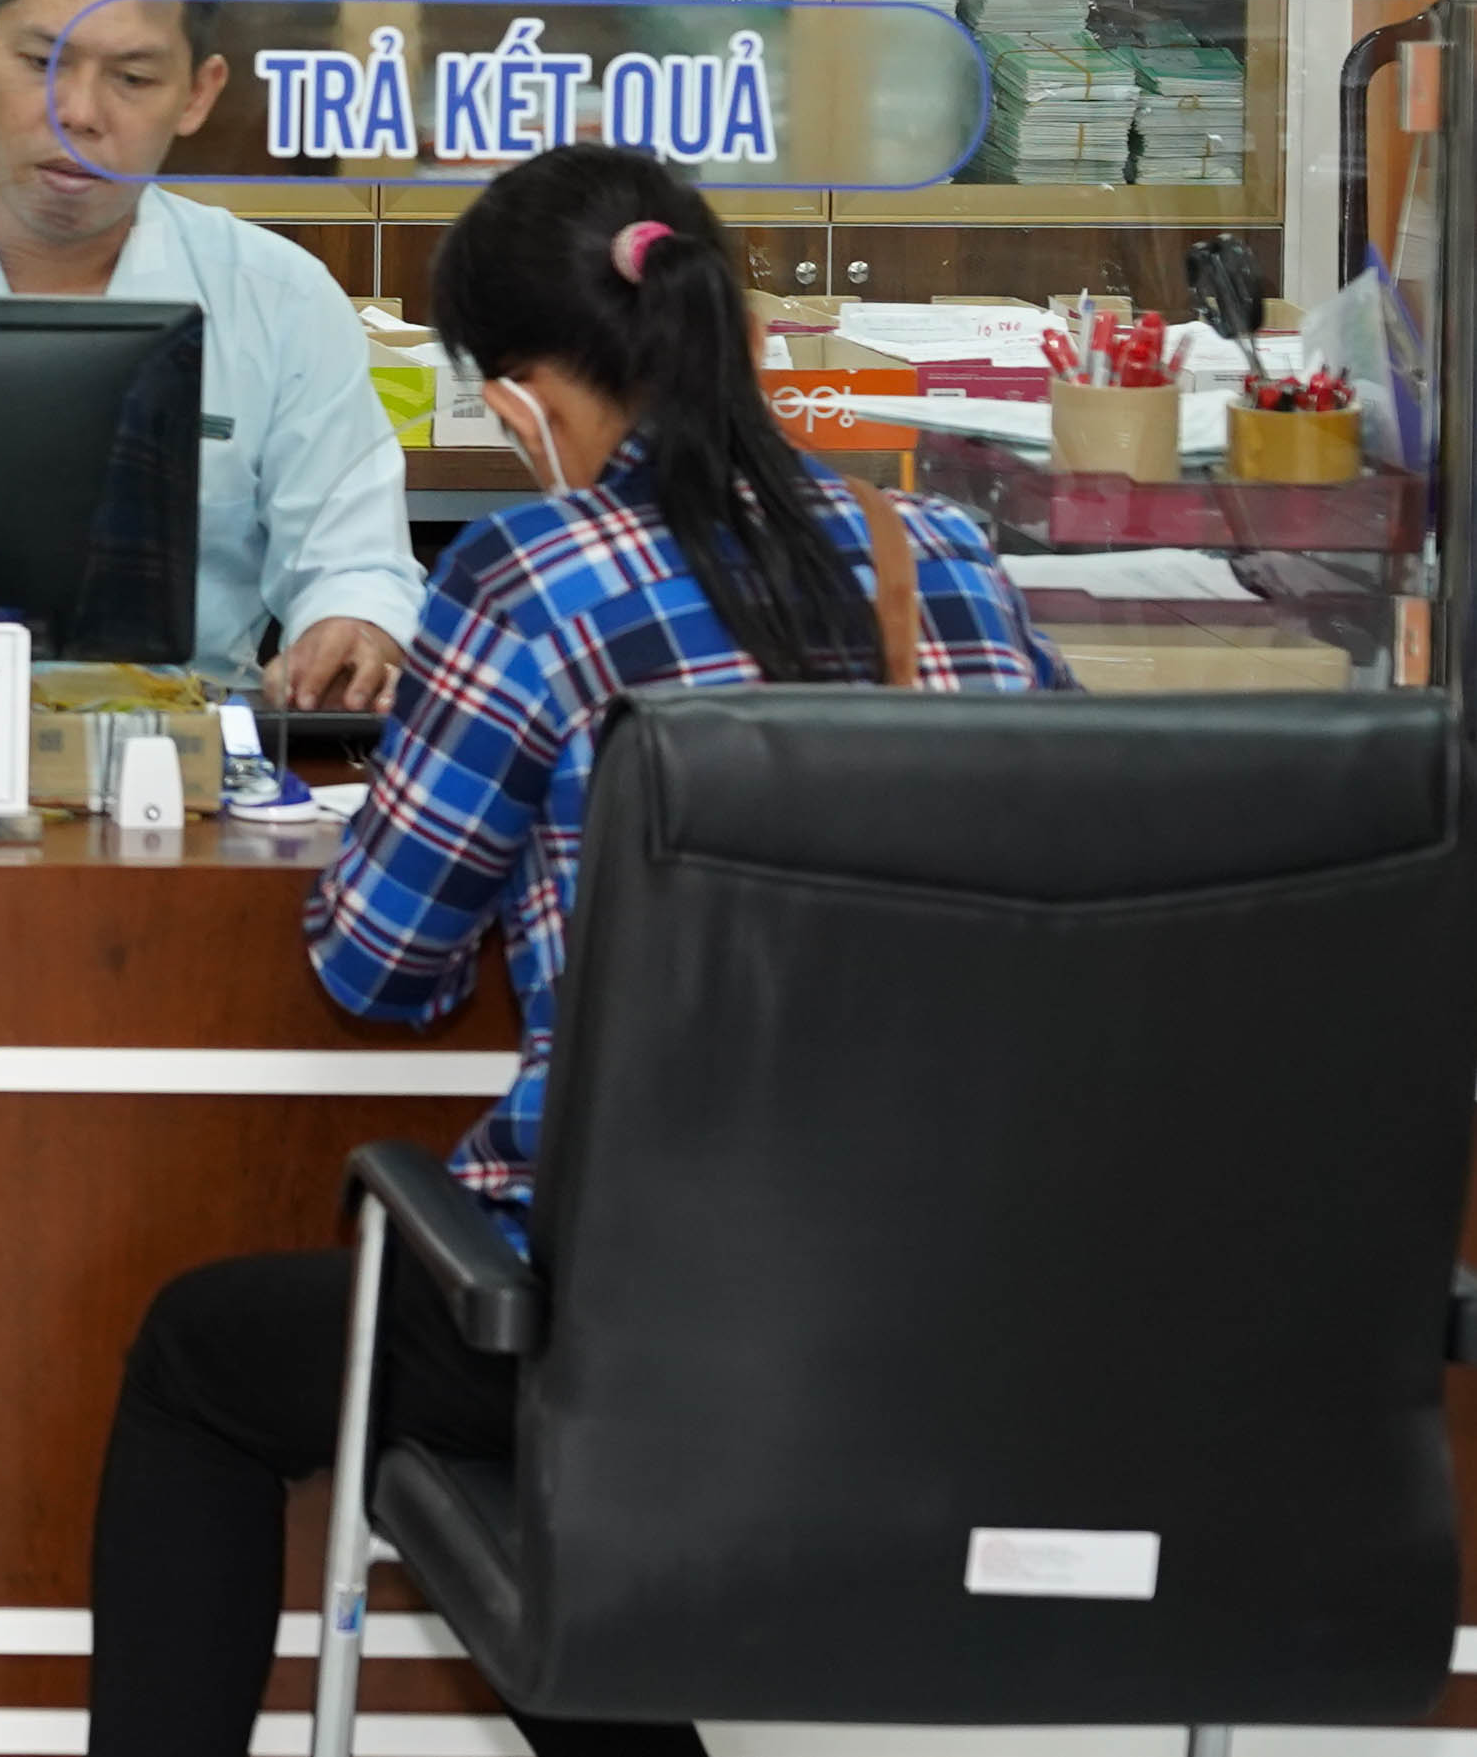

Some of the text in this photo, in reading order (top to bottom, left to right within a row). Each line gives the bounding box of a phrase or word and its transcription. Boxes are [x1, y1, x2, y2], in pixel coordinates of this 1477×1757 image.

[254, 17, 777, 164] TRẢ KẾT QUẢ
